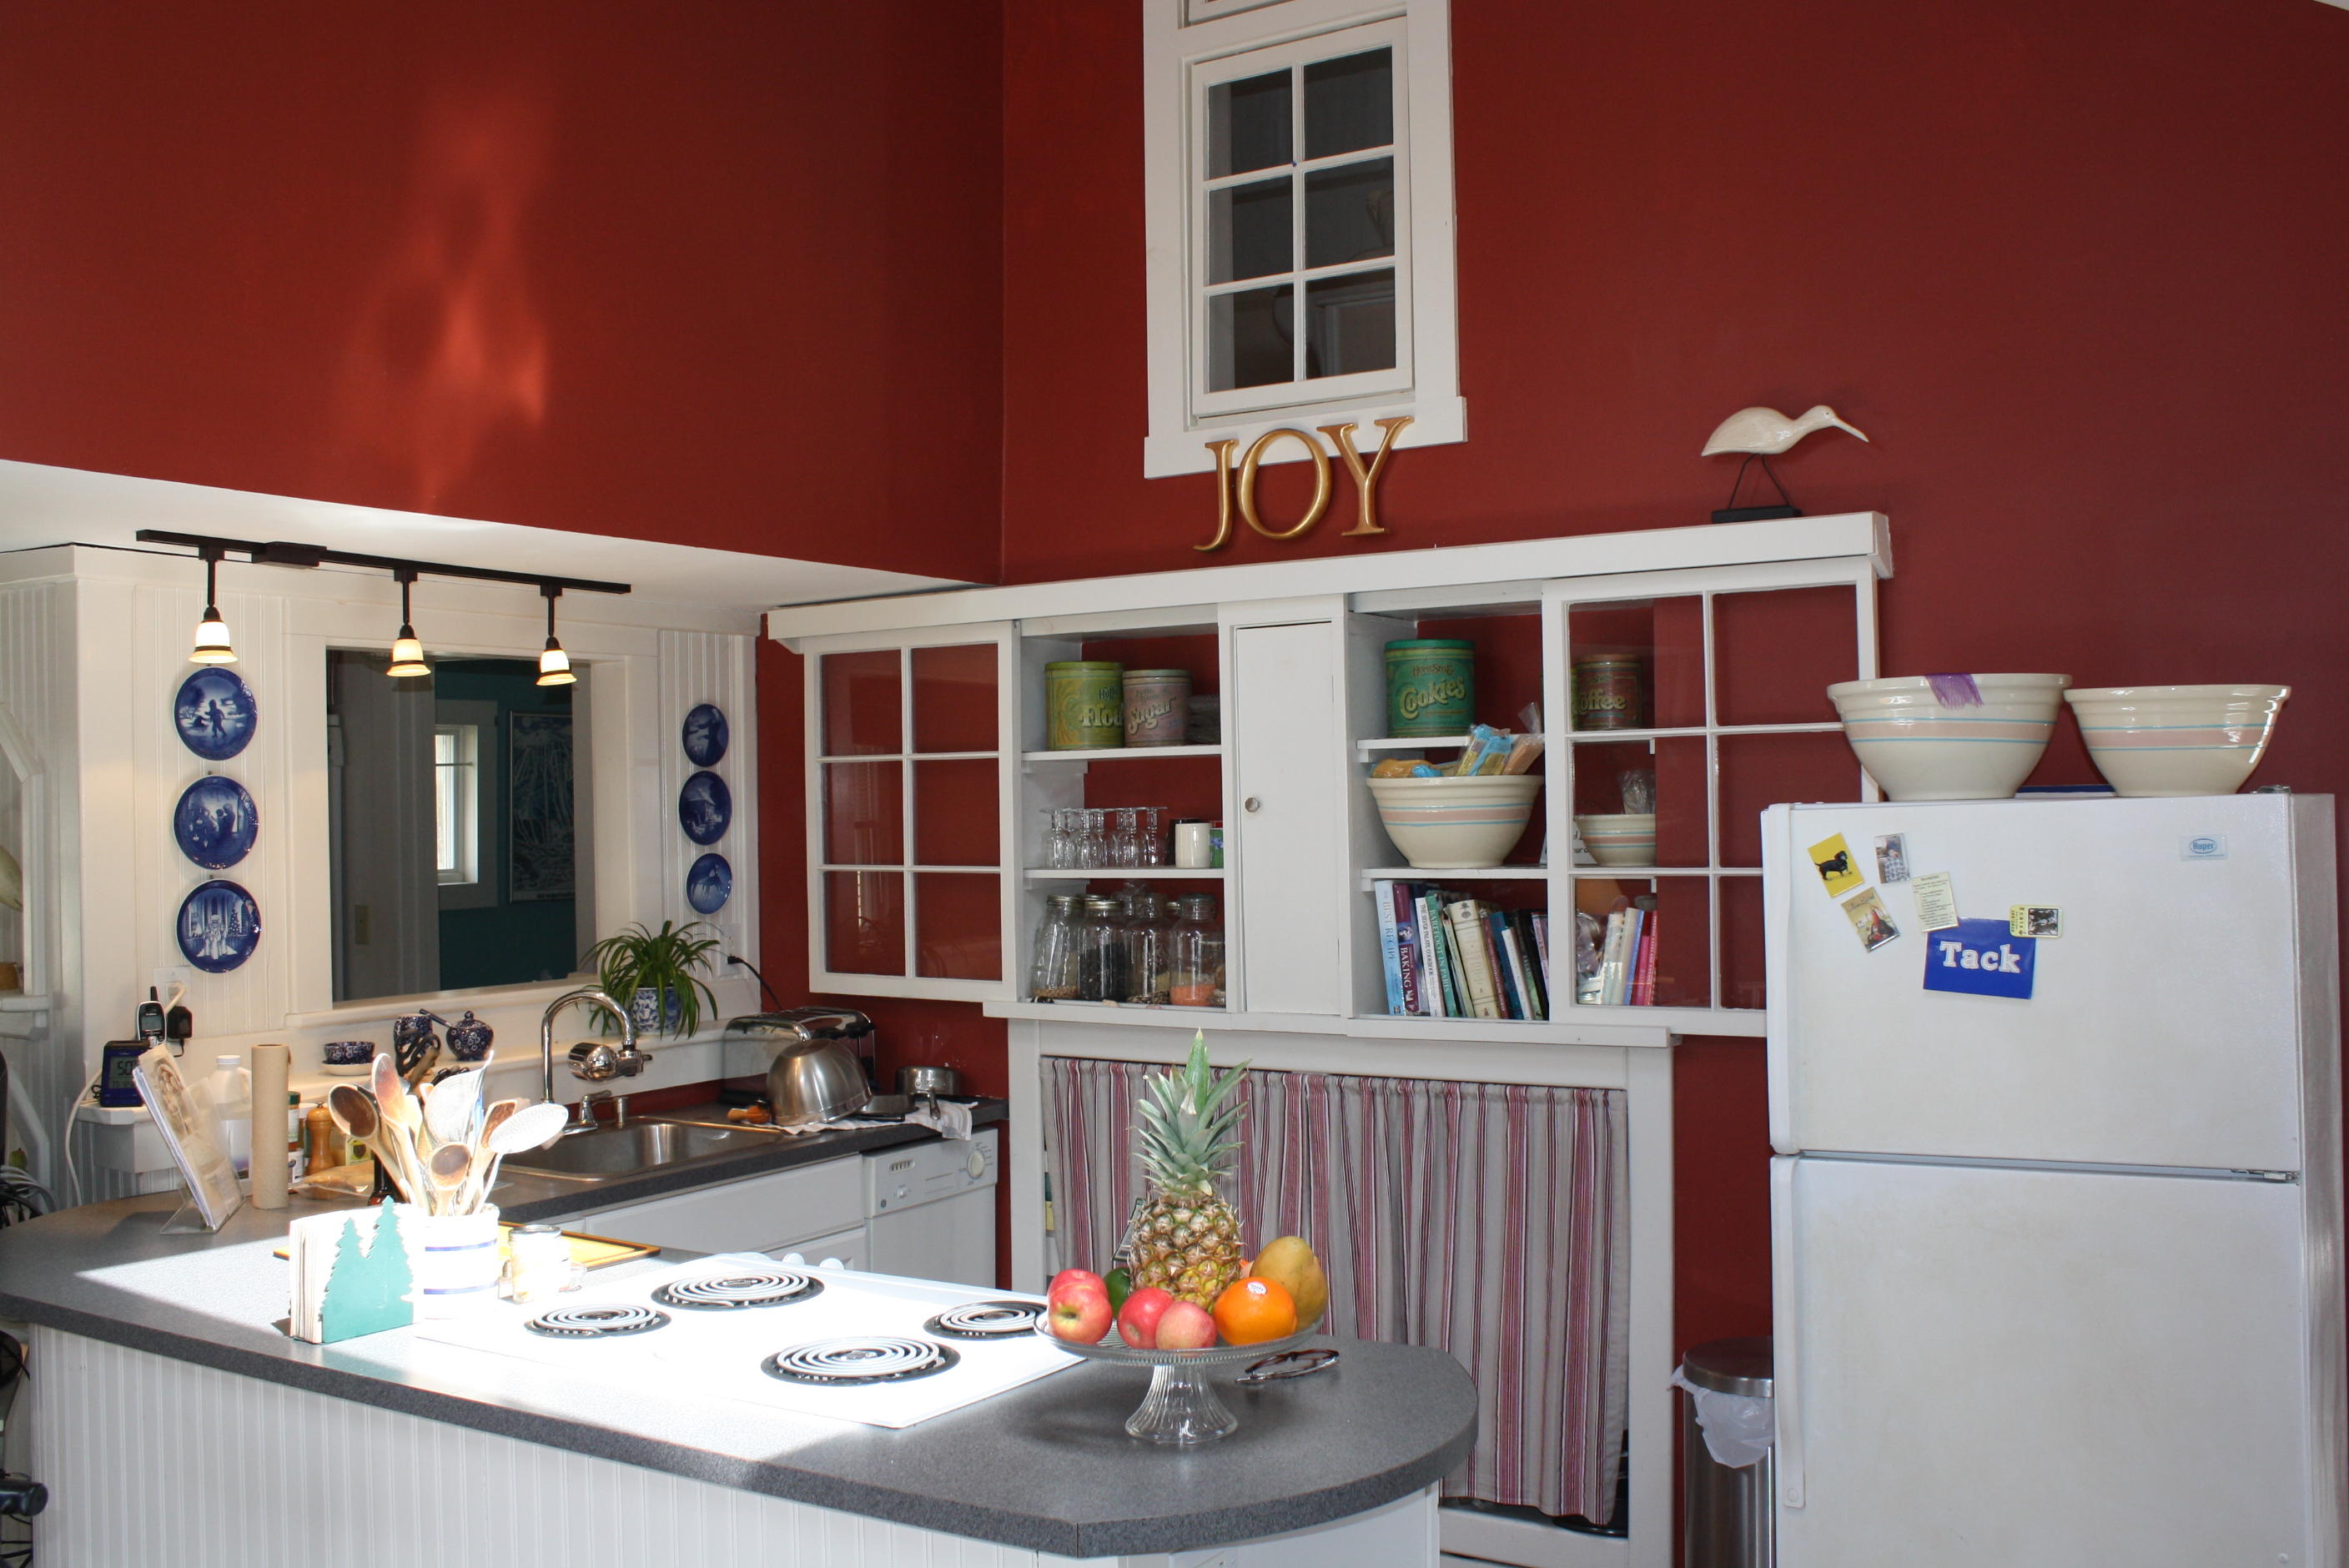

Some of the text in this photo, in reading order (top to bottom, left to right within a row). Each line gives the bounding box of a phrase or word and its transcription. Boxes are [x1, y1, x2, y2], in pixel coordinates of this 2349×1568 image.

[1193, 415, 1416, 553] JOY
[1079, 703, 1124, 728] Flou
[1127, 697, 1177, 735] Sugar
[1401, 677, 1467, 721] Cookies
[2192, 842, 2215, 852] Roper
[1401, 947, 1412, 988] BAKING
[1939, 941, 2020, 973] Tack
